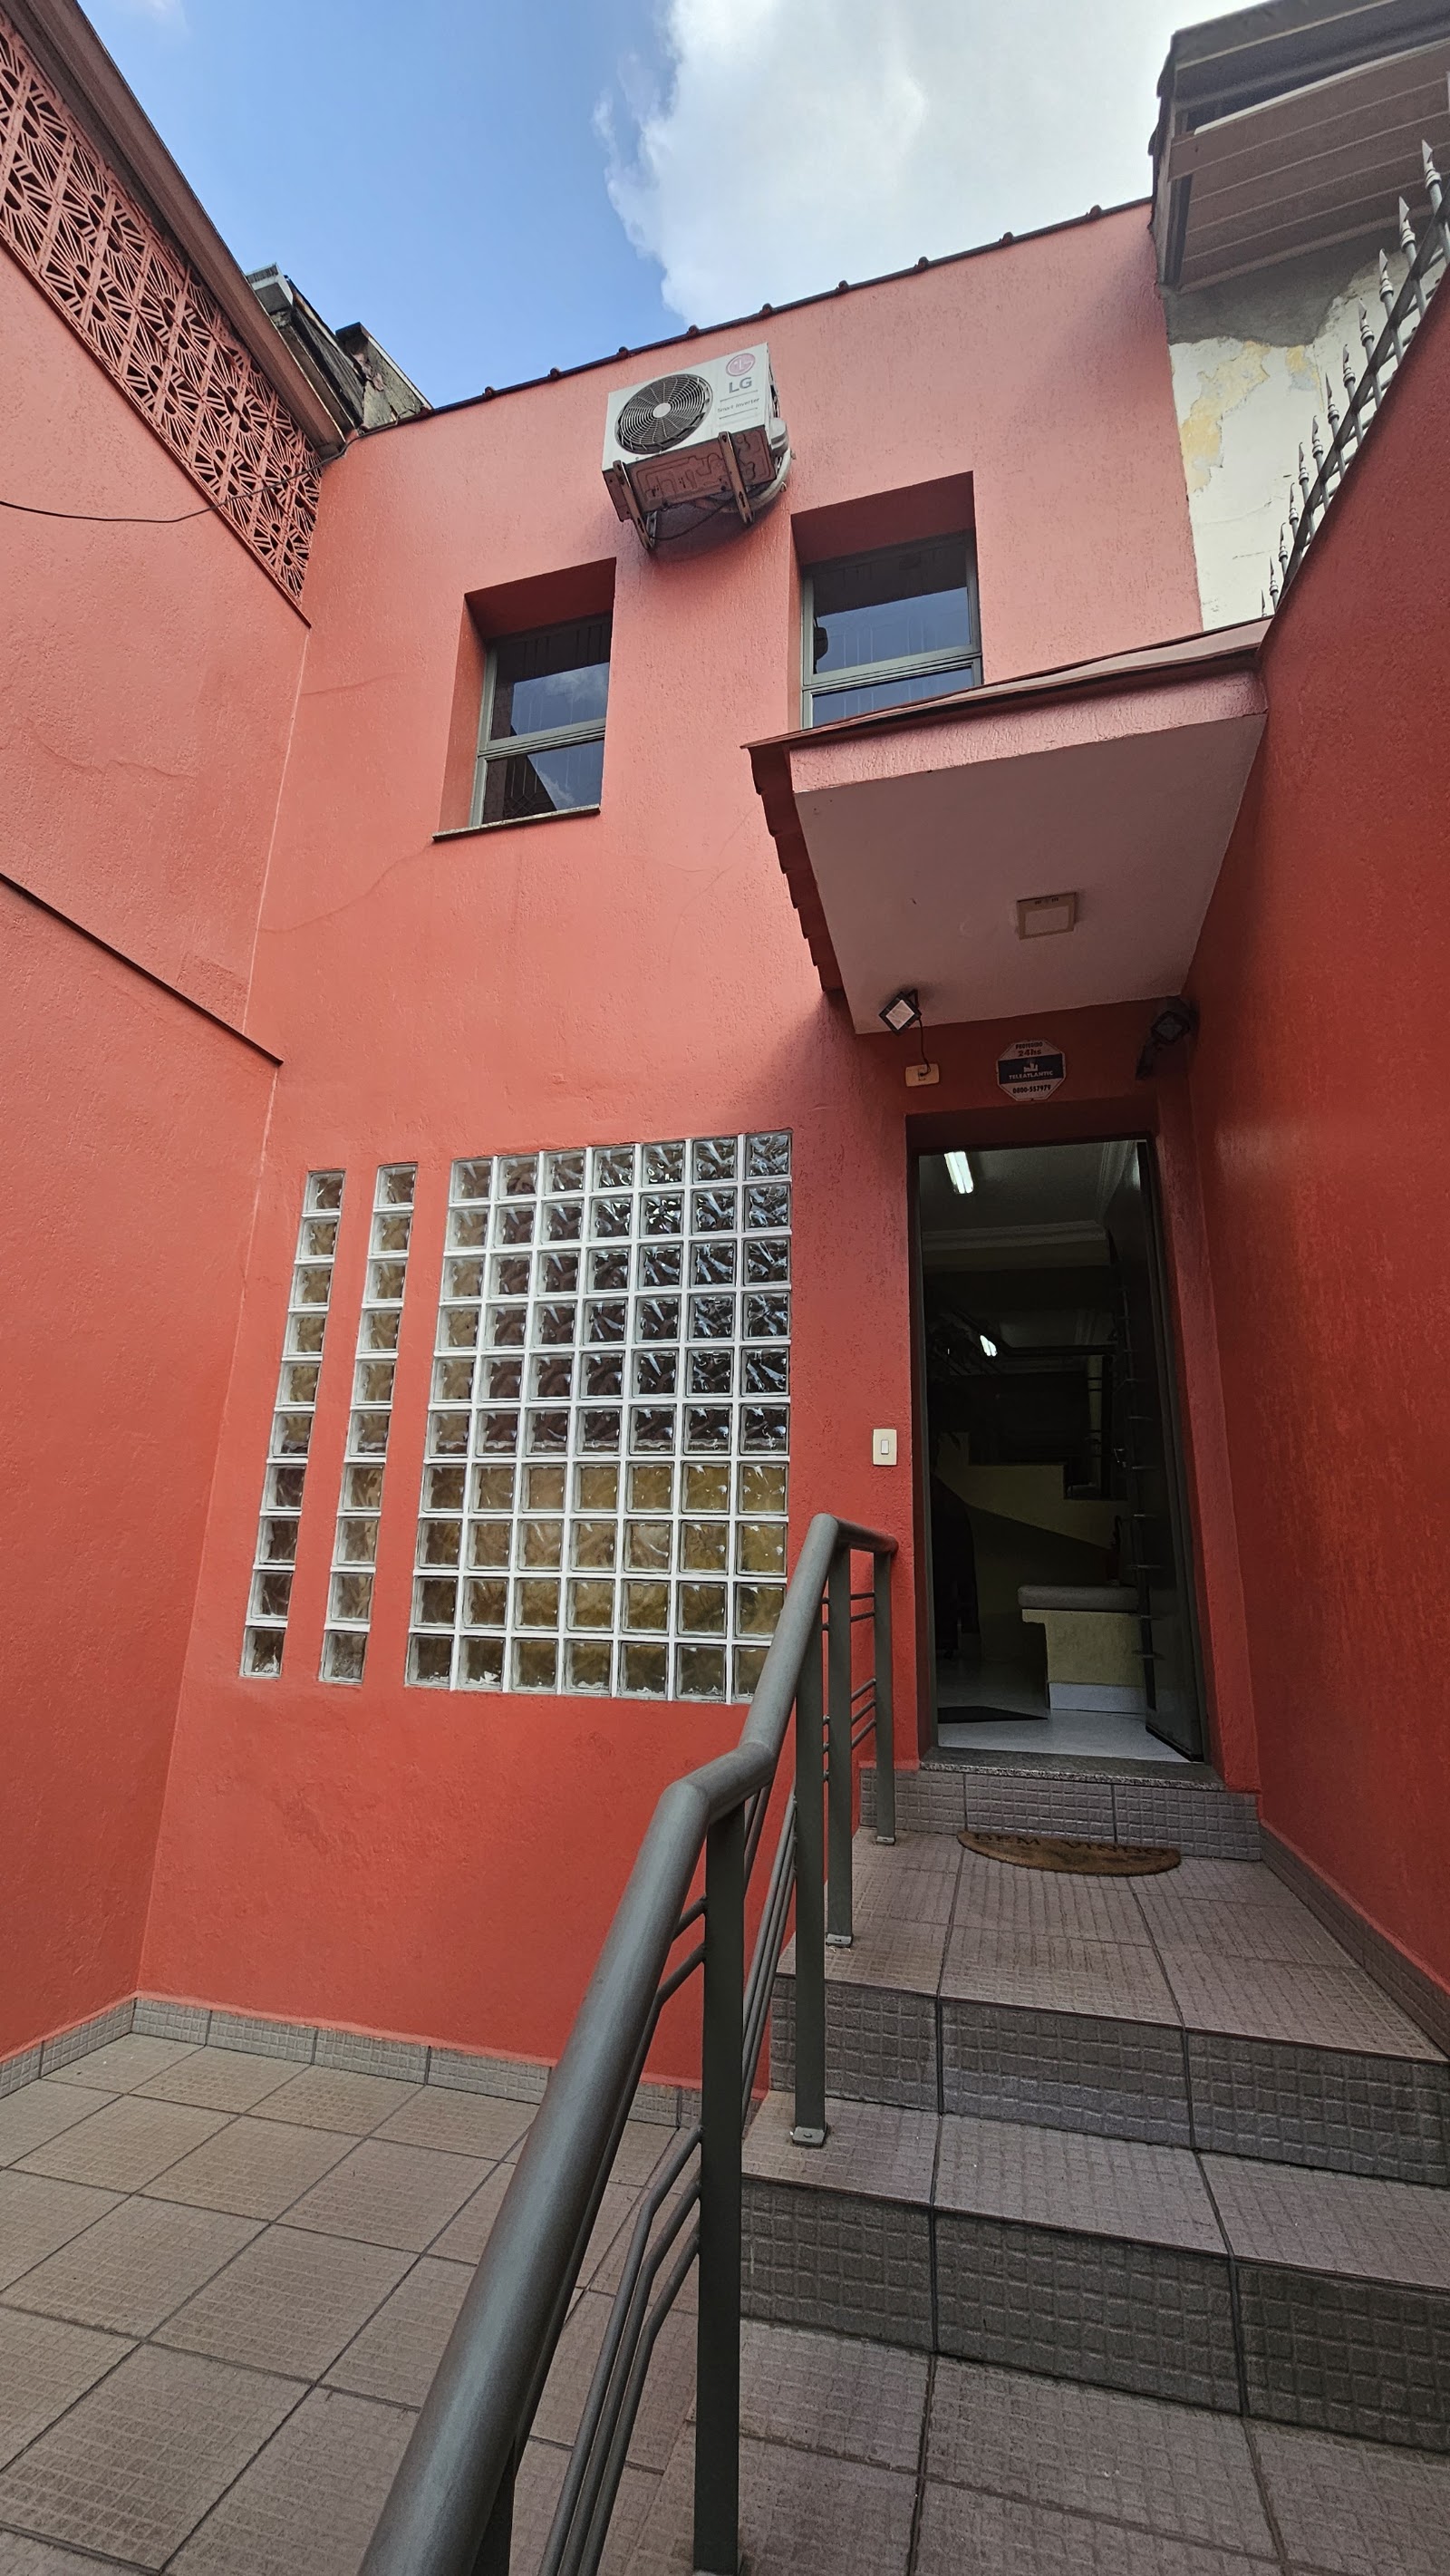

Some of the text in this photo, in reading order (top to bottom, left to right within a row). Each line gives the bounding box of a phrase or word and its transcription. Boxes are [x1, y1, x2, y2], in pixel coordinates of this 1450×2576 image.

[729, 376, 752, 393] LG
[717, 404, 734, 413] Smart
[1018, 1049, 1042, 1057] 24hs
[1009, 1070, 1053, 1080] TELEATLANTIC
